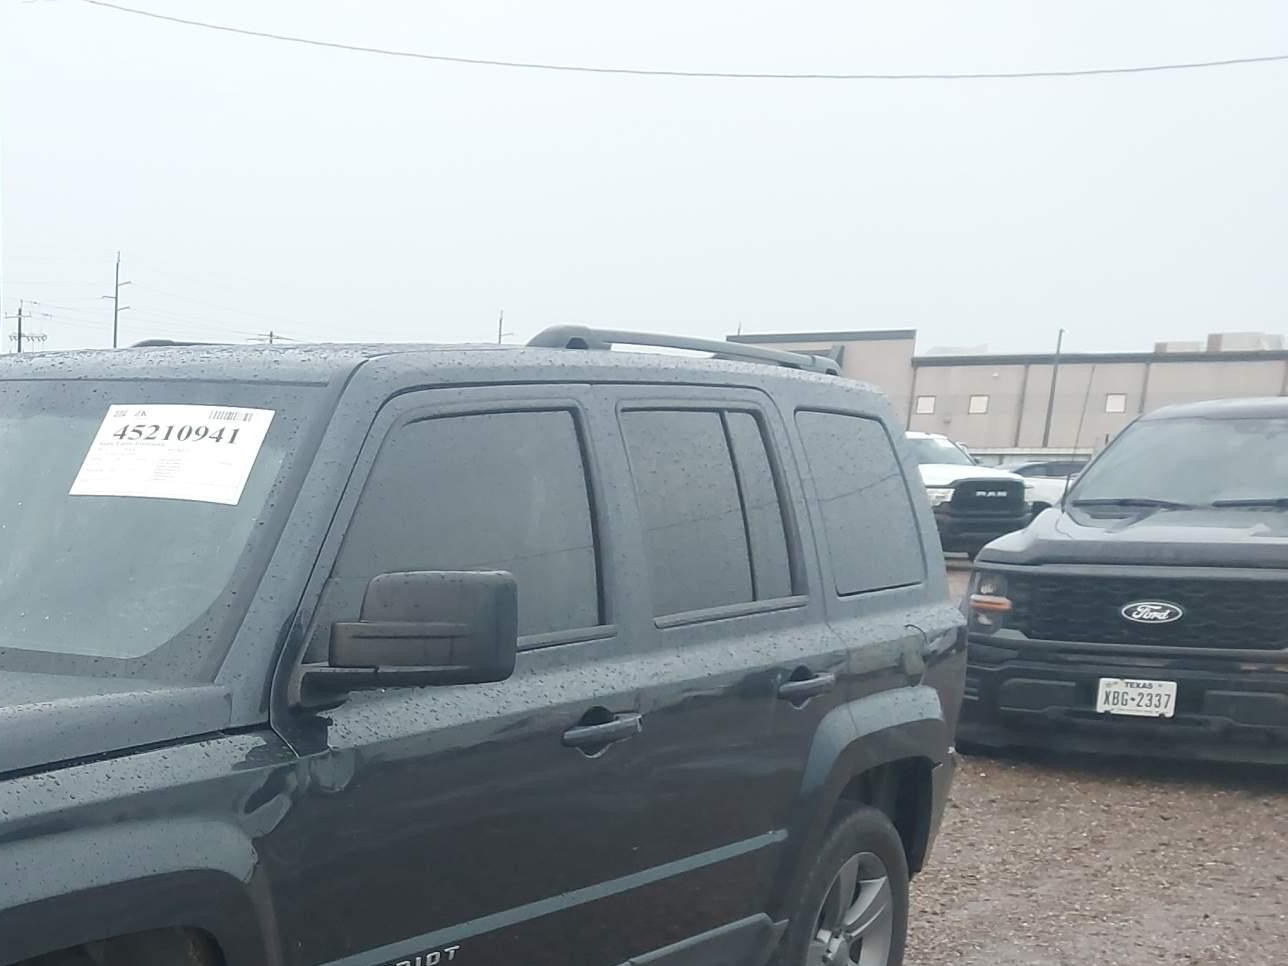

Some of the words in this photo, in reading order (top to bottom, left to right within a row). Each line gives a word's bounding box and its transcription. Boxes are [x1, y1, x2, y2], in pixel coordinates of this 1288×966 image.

[112, 424, 240, 444] 45210941
[1132, 604, 1170, 620] Ford
[1125, 681, 1153, 689] TEXAS
